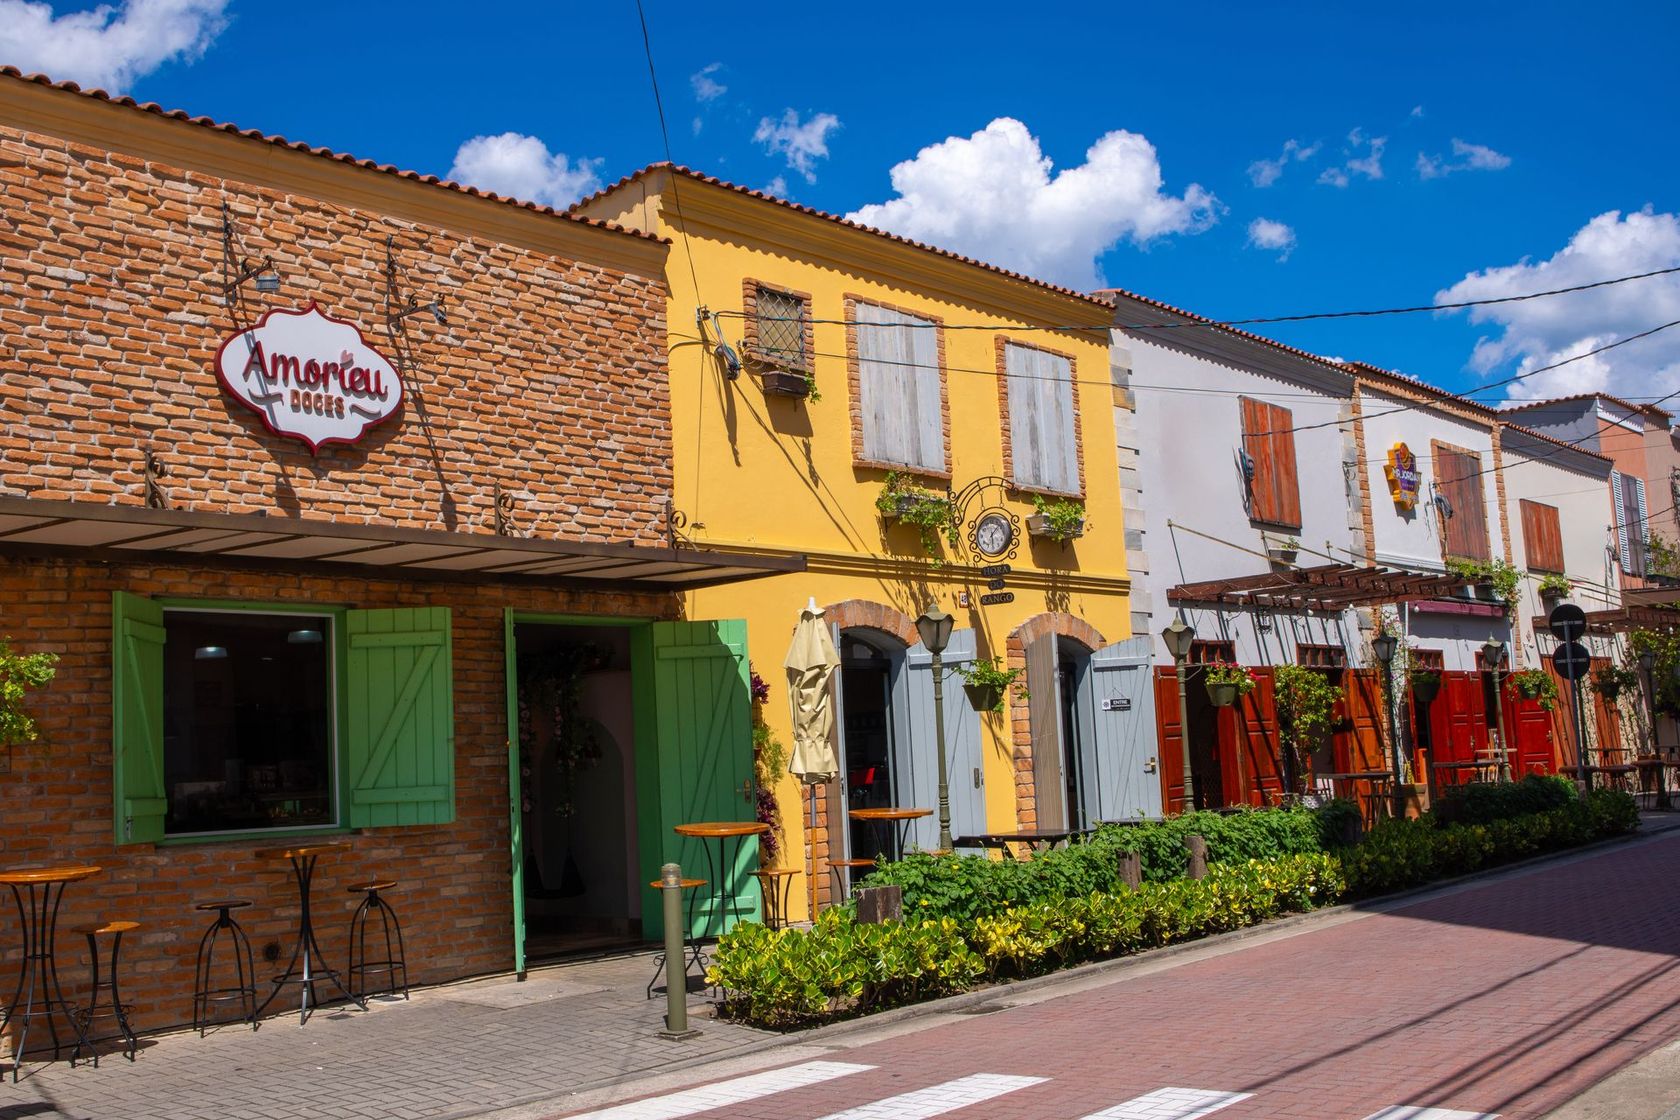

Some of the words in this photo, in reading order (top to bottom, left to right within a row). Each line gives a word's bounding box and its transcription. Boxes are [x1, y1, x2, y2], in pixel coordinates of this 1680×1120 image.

[983, 565, 1009, 576] HORA
[990, 580, 1003, 589] DO
[982, 593, 1013, 604] RANGO
